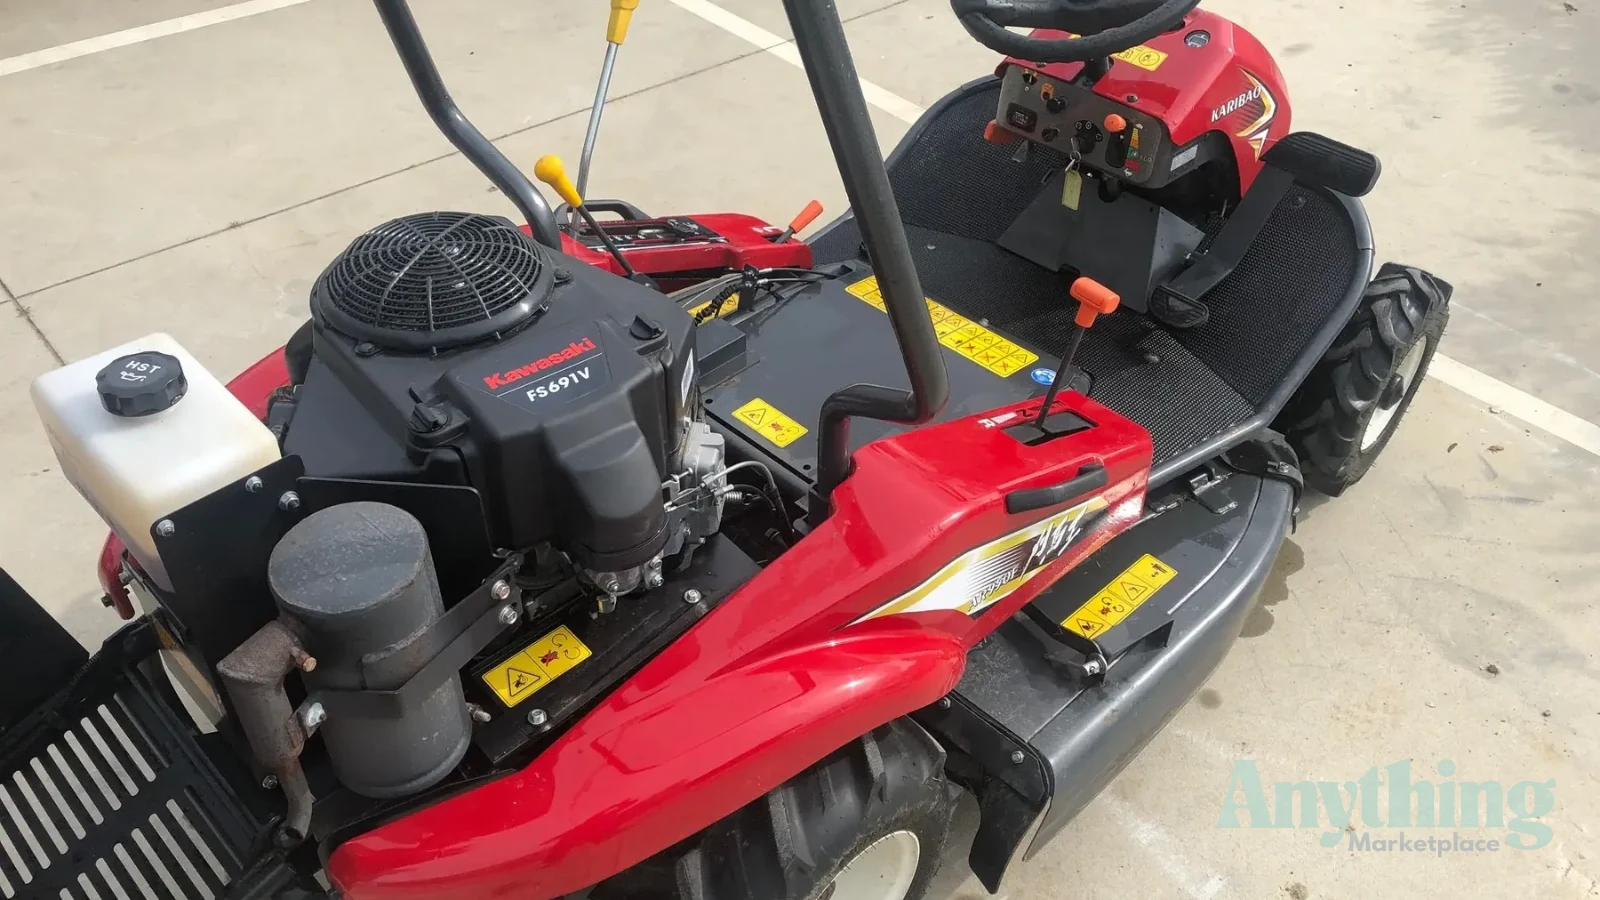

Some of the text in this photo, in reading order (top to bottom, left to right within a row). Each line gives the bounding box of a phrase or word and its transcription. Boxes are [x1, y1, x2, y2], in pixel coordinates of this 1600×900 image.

[1211, 86, 1261, 123] KARIBAO
[126, 361, 161, 374] HST
[484, 337, 597, 390] Kawasaki
[526, 367, 591, 402] FS691V
